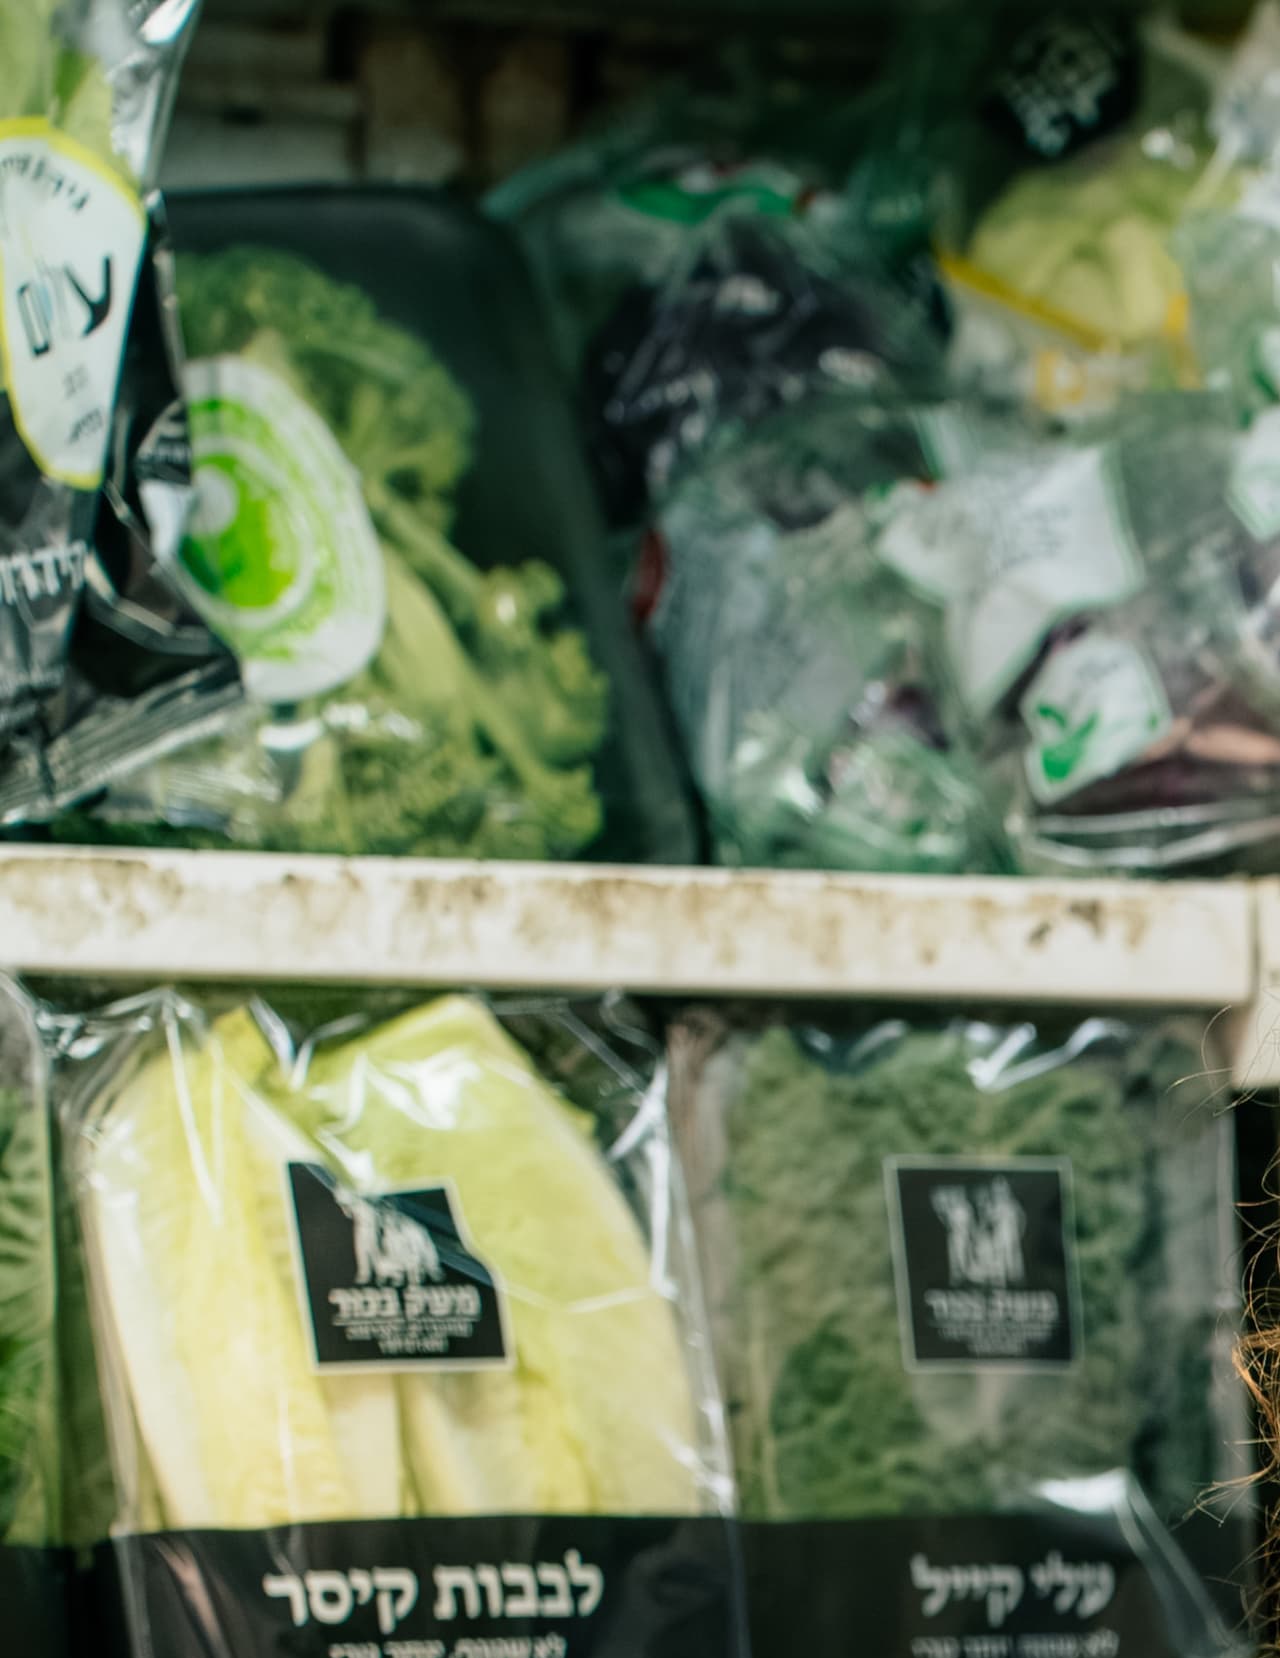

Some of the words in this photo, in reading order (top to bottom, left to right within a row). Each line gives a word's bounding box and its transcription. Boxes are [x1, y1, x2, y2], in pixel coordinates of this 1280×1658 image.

[262, 1565, 419, 1636] קיסר
[432, 1548, 604, 1621] לבבות
[909, 1551, 1025, 1628] קייל
[1029, 1549, 1116, 1620] עלי
